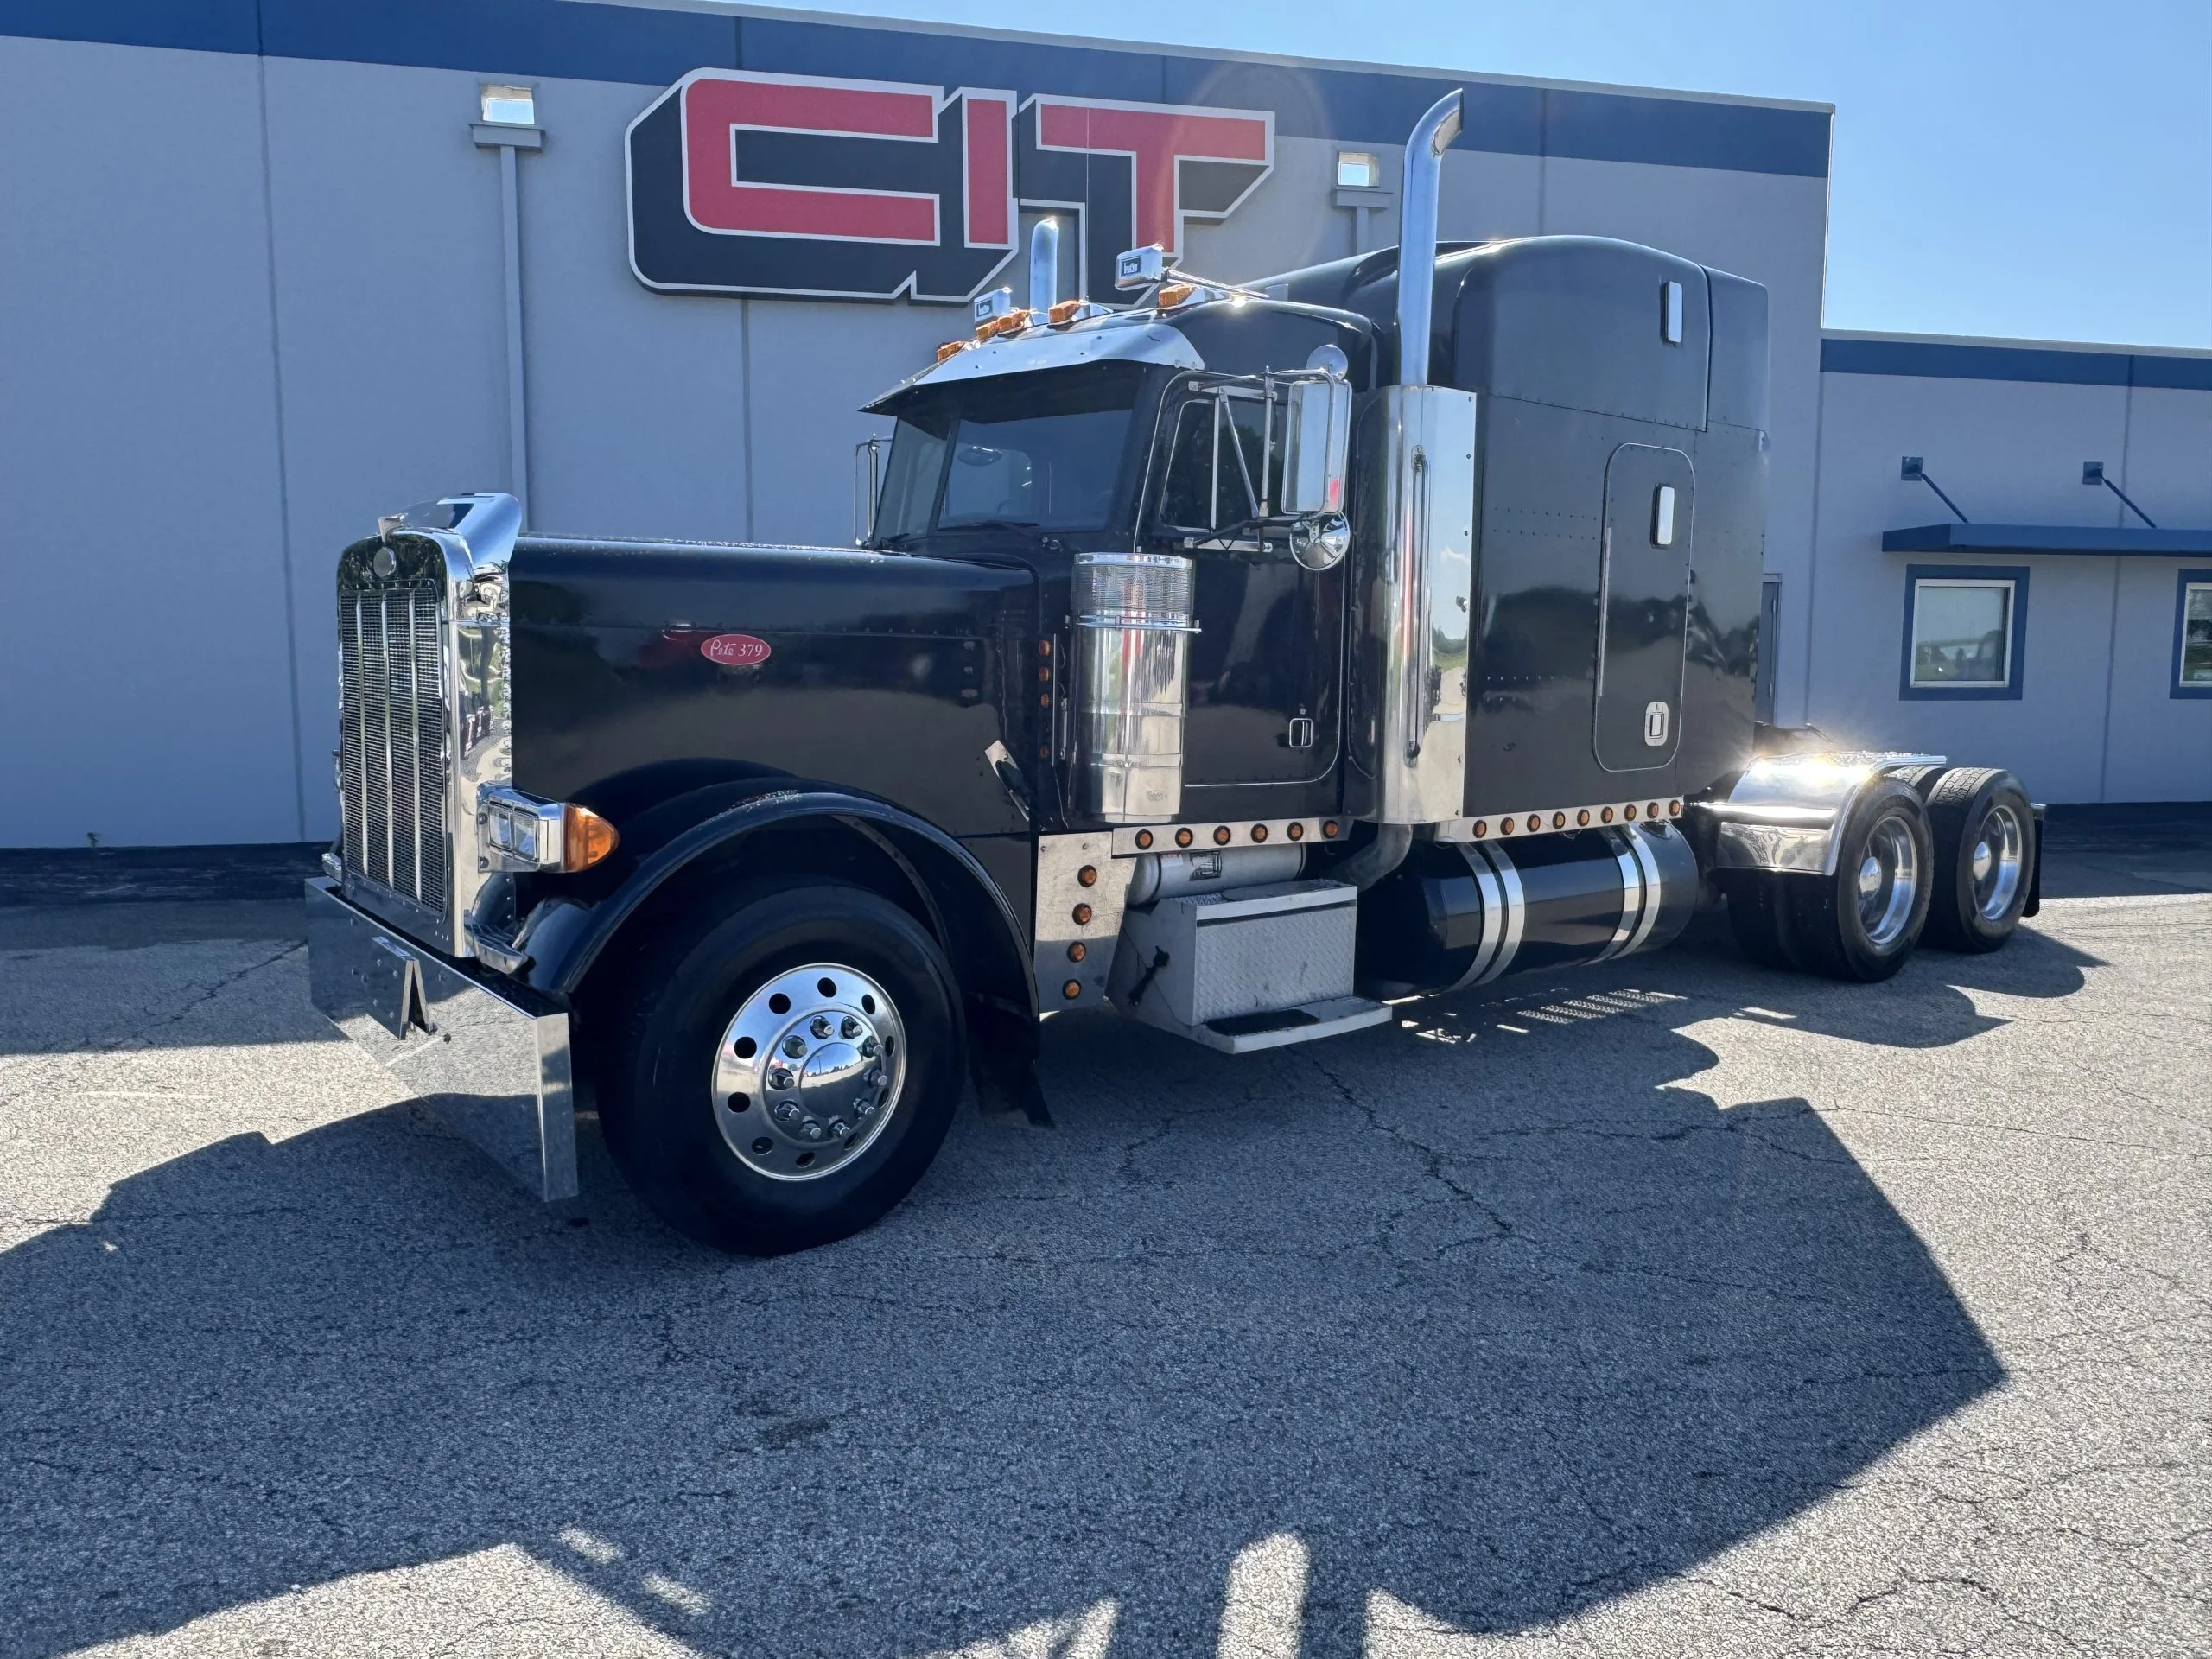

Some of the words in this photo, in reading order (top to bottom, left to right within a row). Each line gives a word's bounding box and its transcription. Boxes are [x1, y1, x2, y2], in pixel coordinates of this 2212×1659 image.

[679, 67, 1276, 263] CIT
[709, 639, 737, 658] Pete
[738, 644, 763, 658] 379
